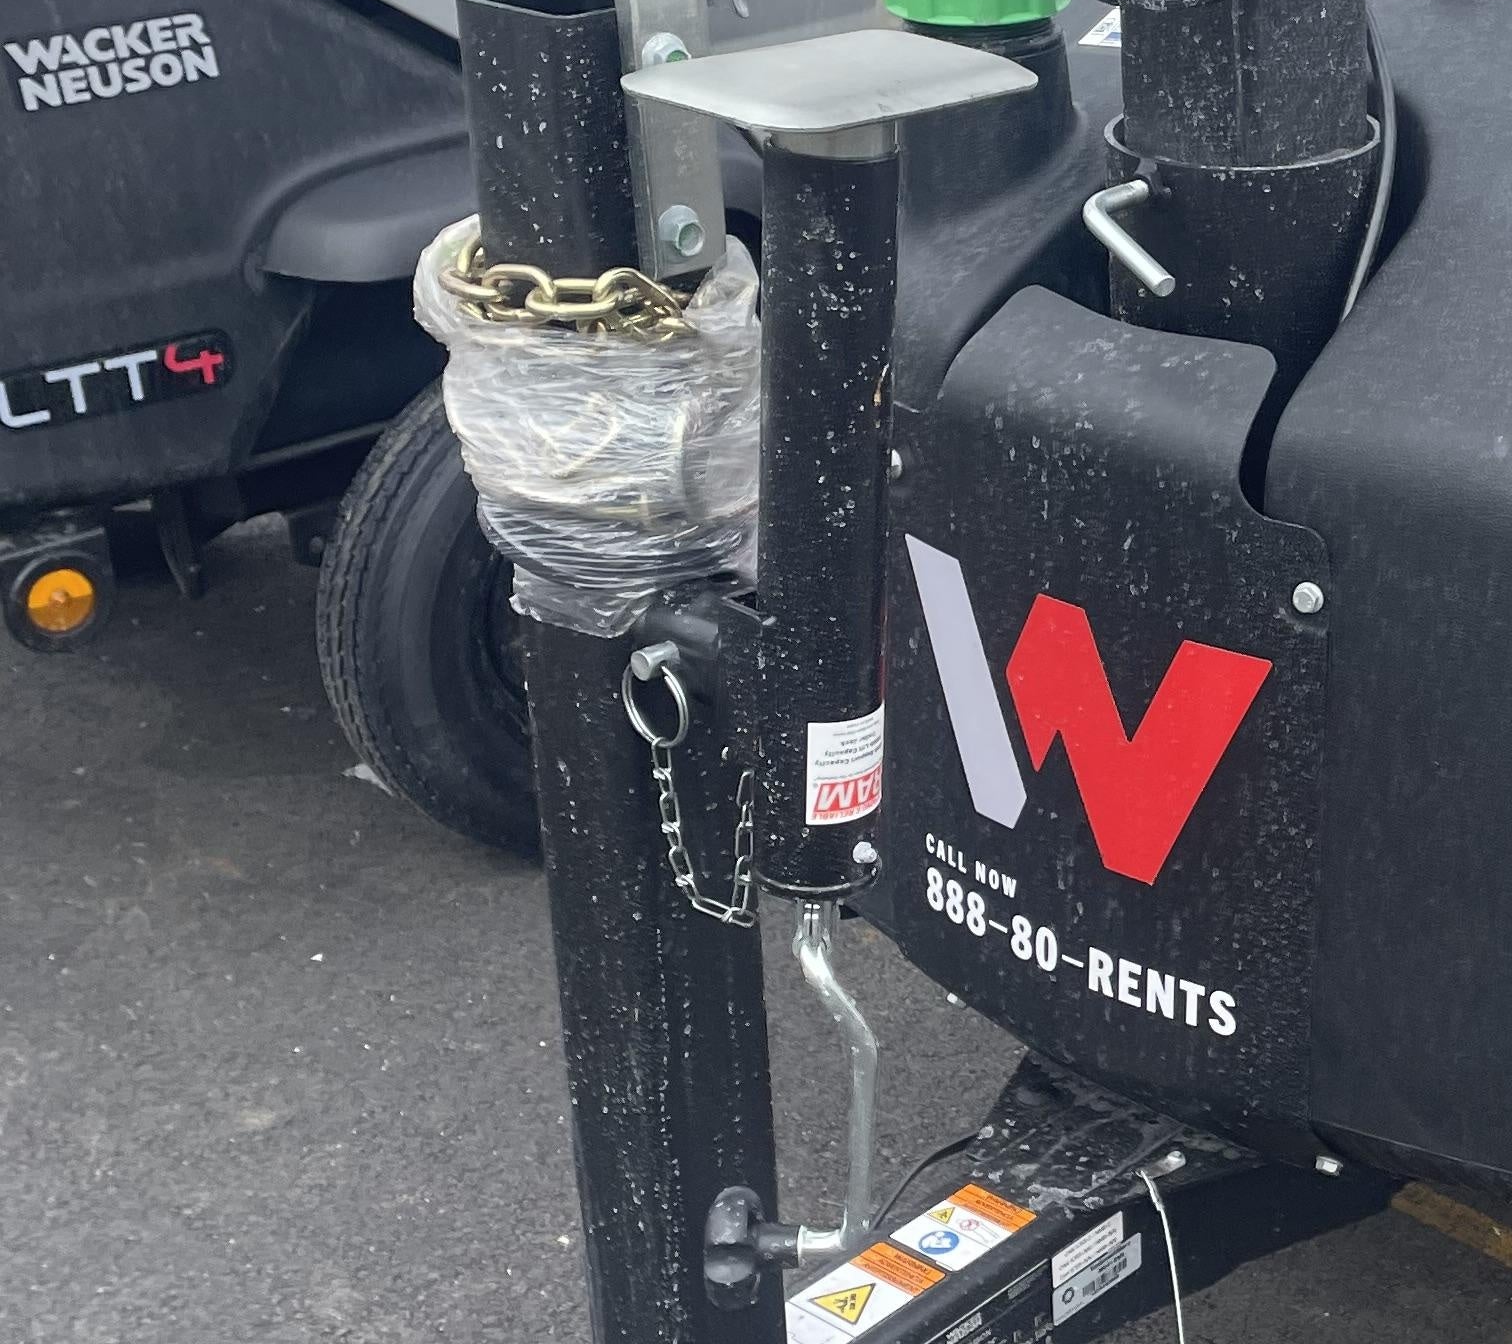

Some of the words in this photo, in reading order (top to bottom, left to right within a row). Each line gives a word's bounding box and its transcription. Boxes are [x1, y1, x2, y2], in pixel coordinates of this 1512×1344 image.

[4, 13, 210, 74] WACKER
[18, 45, 219, 111] NEUSON
[925, 832, 967, 874] CALL
[975, 860, 1017, 898] NOW
[926, 866, 1237, 1036] 888-80-RENTS
